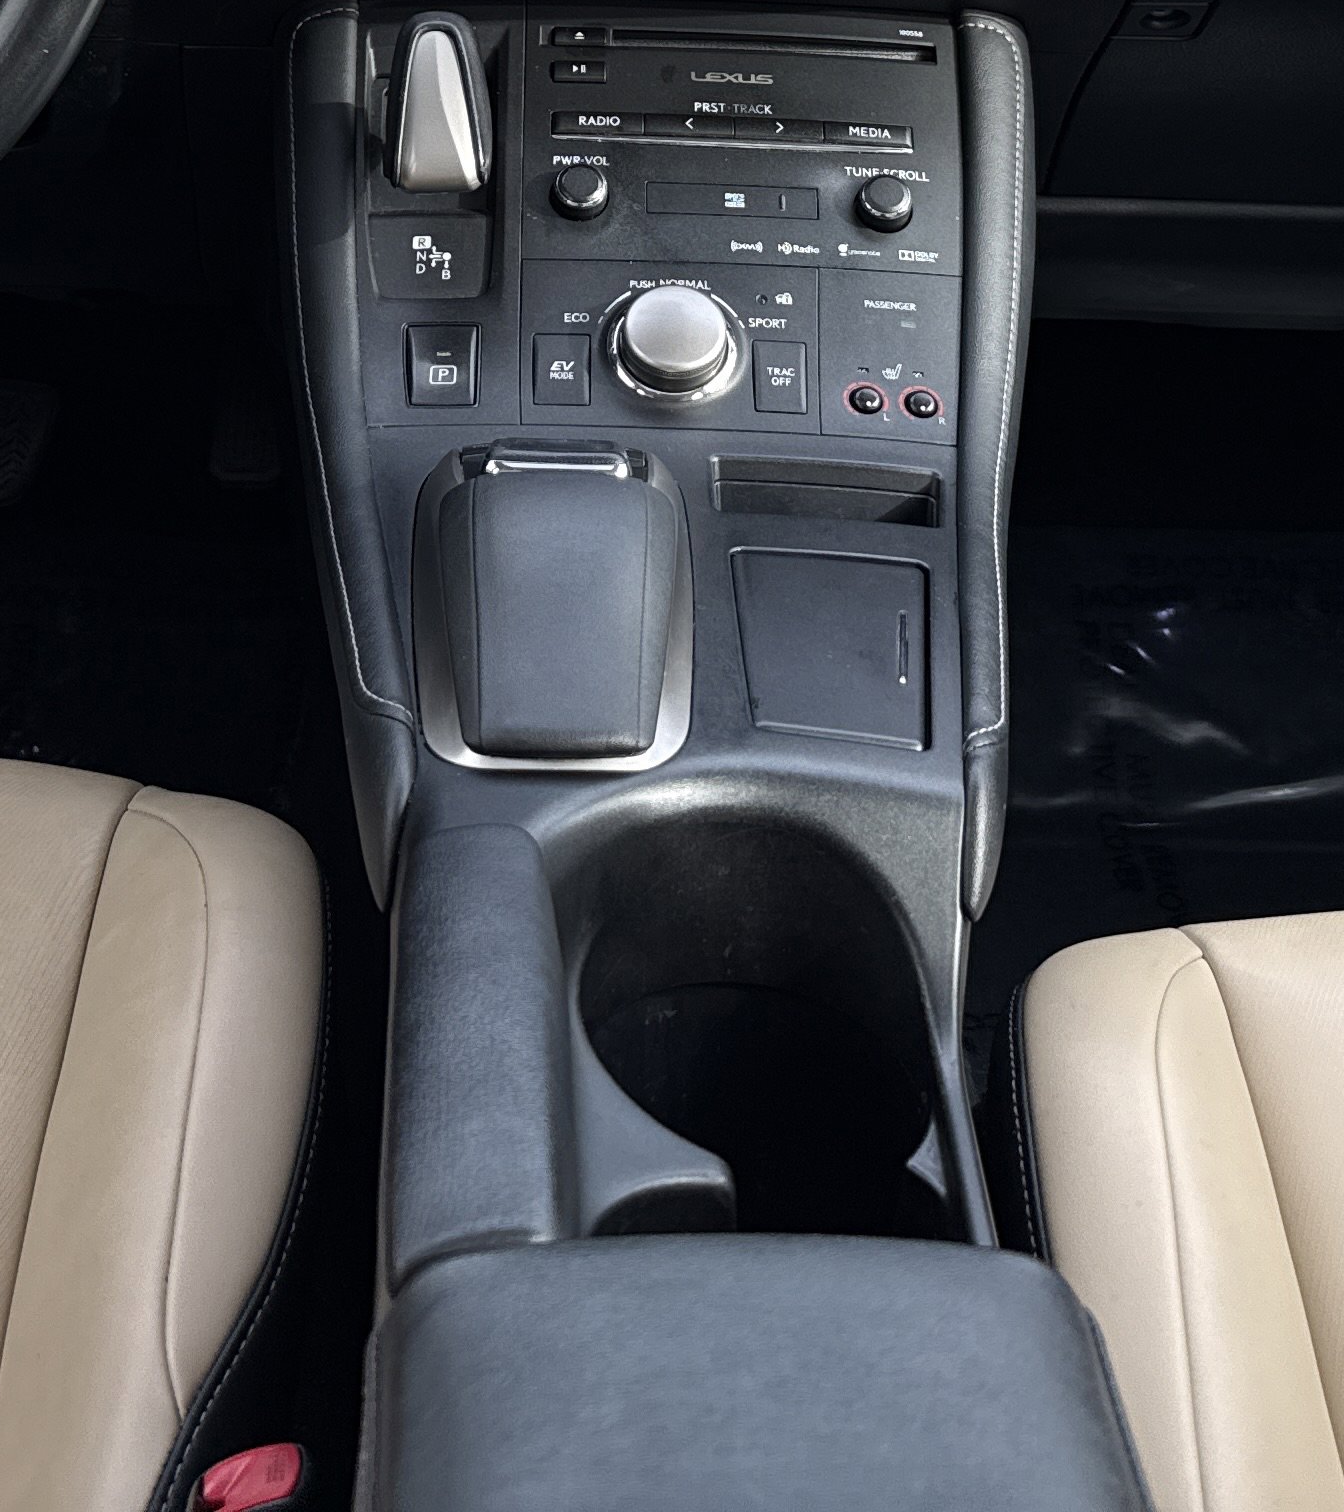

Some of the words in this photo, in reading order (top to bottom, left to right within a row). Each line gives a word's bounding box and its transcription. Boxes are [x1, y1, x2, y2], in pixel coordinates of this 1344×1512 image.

[690, 71, 774, 85] LEXUS
[577, 115, 621, 128] RADIO
[848, 125, 892, 139] MEDIA
[793, 244, 820, 255] Radio
[416, 251, 427, 262] N
[415, 263, 426, 274] D
[441, 269, 452, 280] B
[629, 279, 656, 289] PUSH
[863, 299, 917, 311] PASSENGER
[563, 313, 590, 323] ECO
[748, 317, 788, 329] SPORT
[549, 360, 575, 371] EV
[549, 371, 574, 380] MODE
[766, 366, 796, 377] TRAC
[771, 376, 792, 387] OFF
[882, 412, 891, 422] L
[938, 416, 947, 426] R
